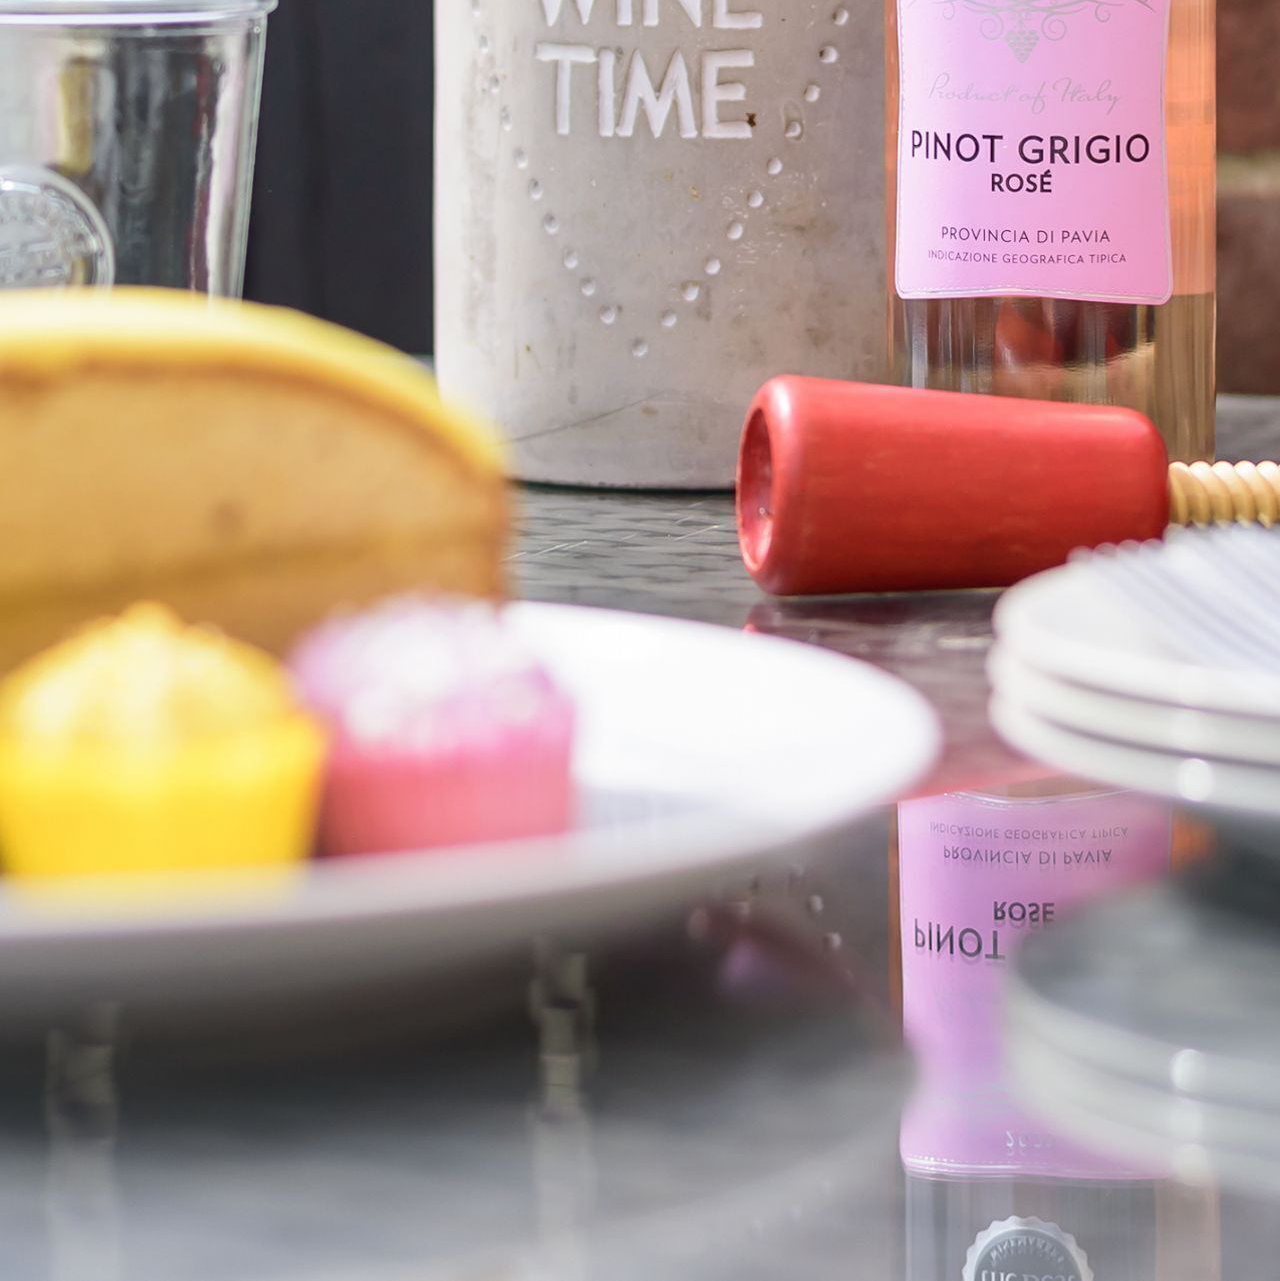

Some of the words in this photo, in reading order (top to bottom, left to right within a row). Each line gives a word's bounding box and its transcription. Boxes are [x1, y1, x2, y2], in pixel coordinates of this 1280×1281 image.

[535, 42, 754, 139] TIME
[928, 72, 1018, 101] Product
[1017, 81, 1046, 115] of
[1052, 77, 1121, 115] Italy
[911, 130, 1003, 163] PINOT
[1018, 133, 1150, 165] GRIGIO
[990, 169, 1052, 193] ROSÉ
[941, 226, 1030, 244] PROVINCIA
[1037, 229, 1054, 244] DI
[1061, 230, 1111, 243] PAVIA
[928, 250, 998, 264] INDICAZIONE
[1002, 253, 1085, 265] GEOGRAFICA
[1090, 253, 1127, 264] TIPICA
